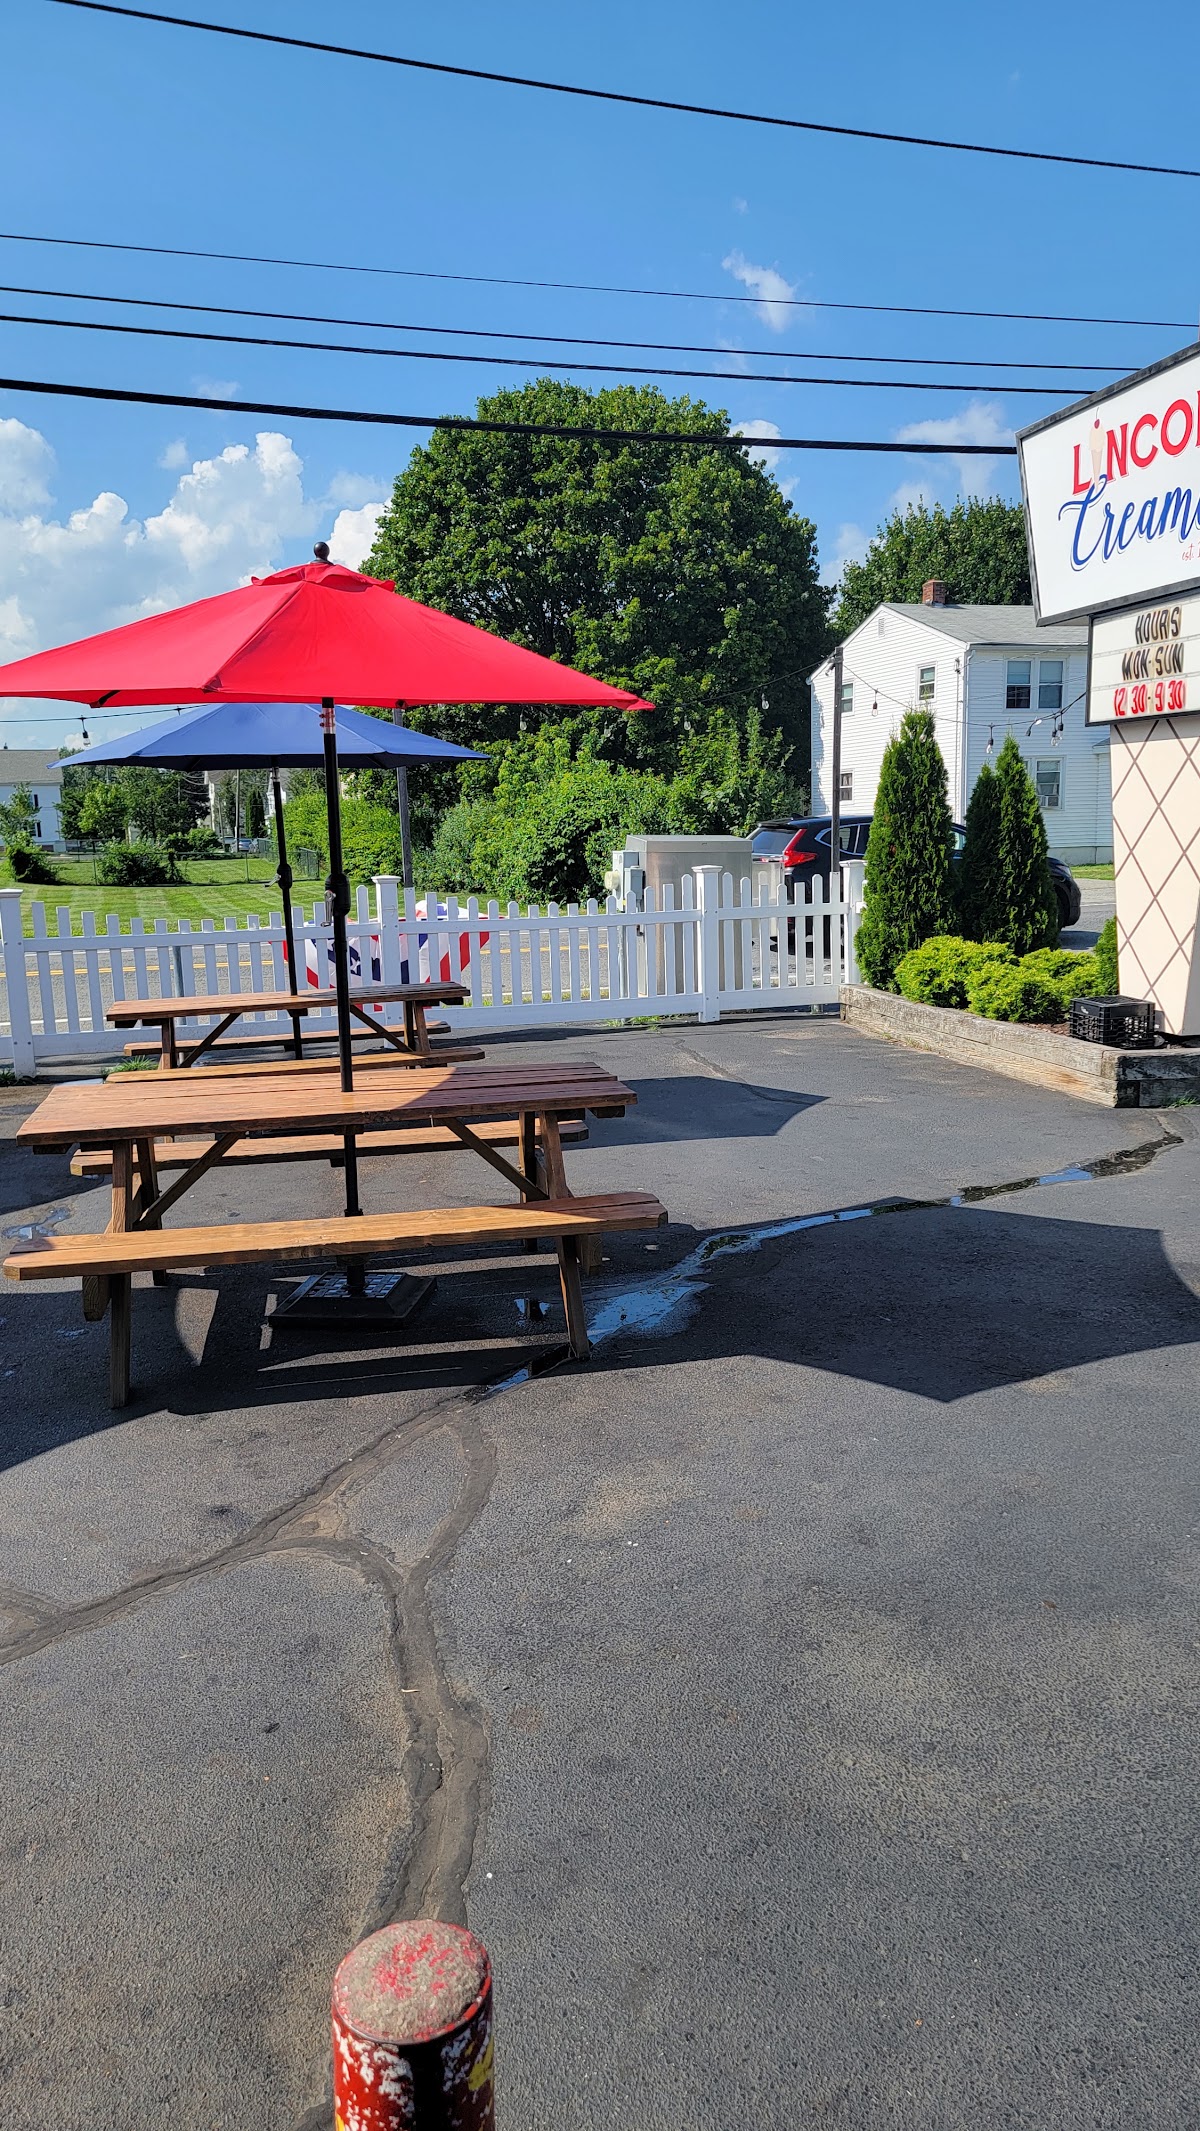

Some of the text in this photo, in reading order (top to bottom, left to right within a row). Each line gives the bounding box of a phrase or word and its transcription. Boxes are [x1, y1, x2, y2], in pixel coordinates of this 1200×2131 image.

[1072, 390, 1200, 495] LINCO
[1058, 474, 1200, 569] Cream
[1135, 606, 1180, 645] HOURS
